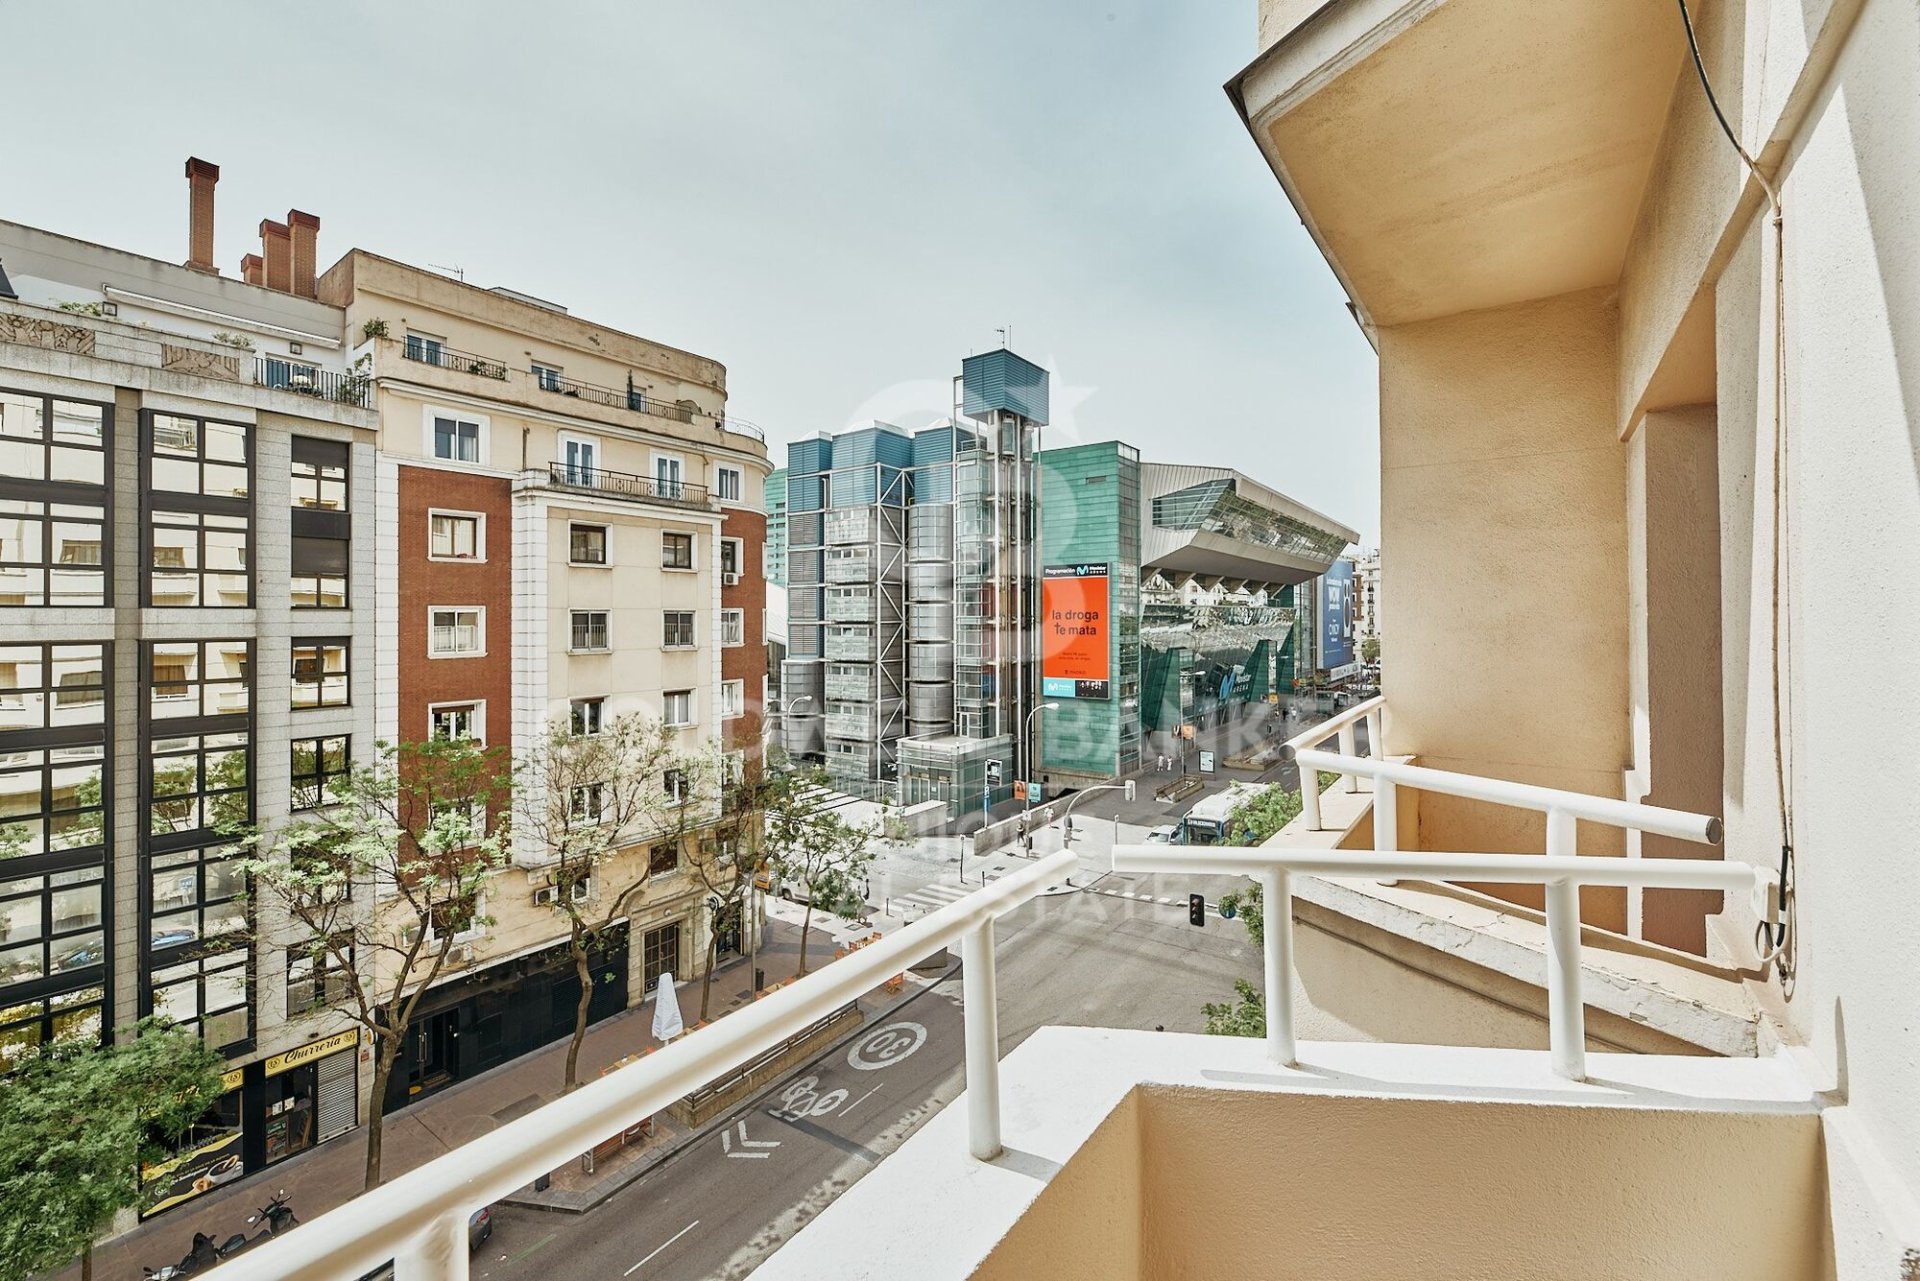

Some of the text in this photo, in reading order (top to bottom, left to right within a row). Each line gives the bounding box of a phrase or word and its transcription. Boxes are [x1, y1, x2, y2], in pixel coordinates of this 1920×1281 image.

[1052, 609, 1099, 622] la droga
[1068, 625, 1097, 635] mata
[865, 1031, 912, 1059] 30
